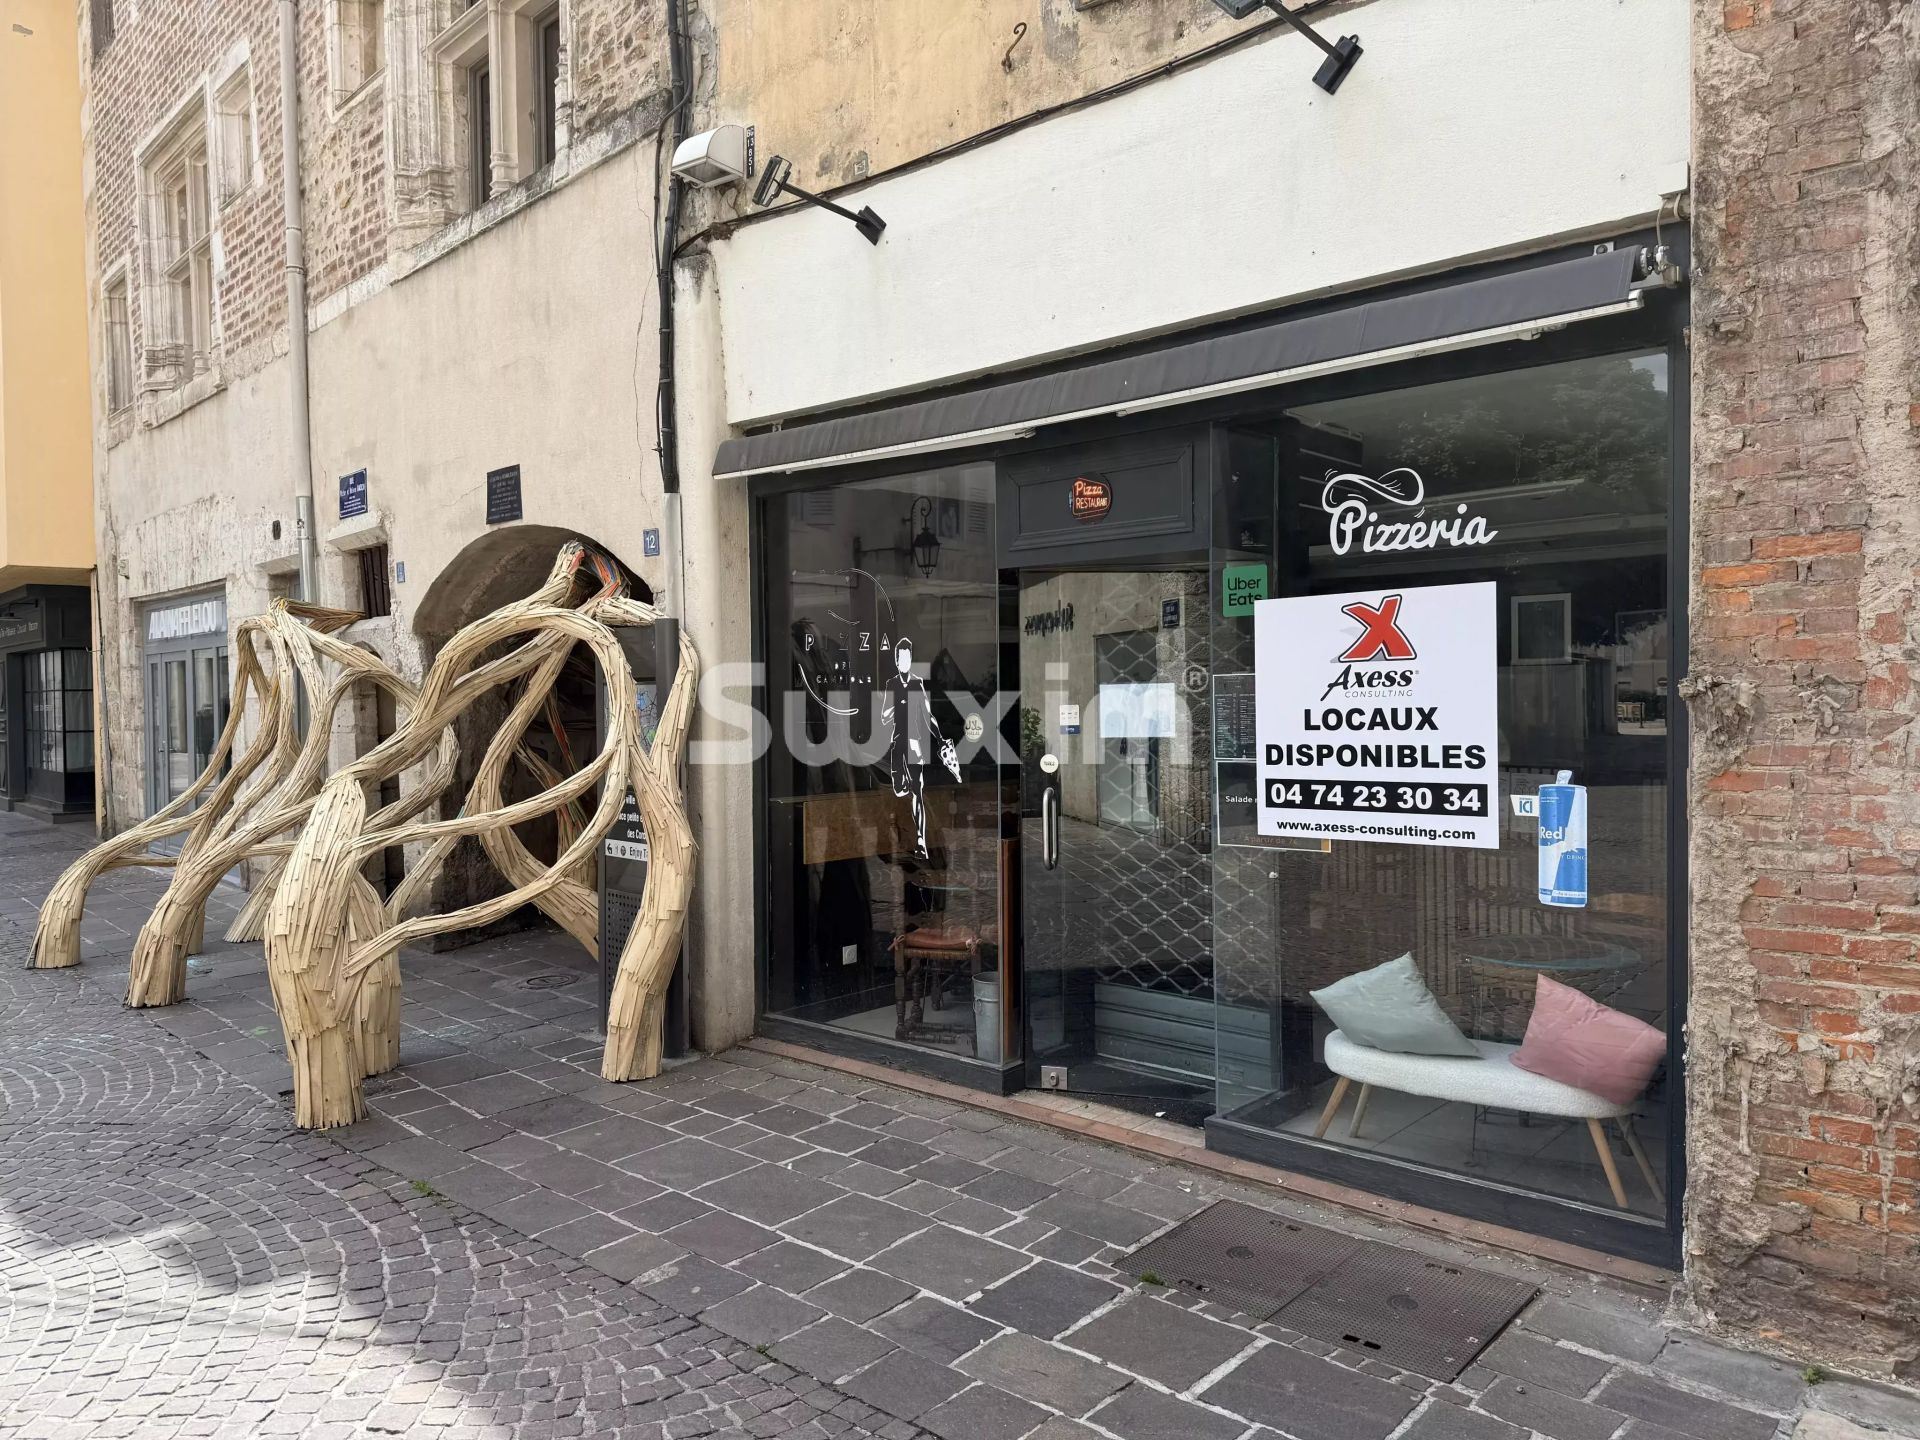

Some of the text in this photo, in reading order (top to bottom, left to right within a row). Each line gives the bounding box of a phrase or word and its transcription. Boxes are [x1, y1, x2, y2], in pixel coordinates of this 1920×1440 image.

[1074, 481, 1104, 496] Pizza
[1075, 498, 1108, 509] RESTAURANT
[645, 534, 656, 549] 12
[1227, 577, 1262, 591] Uber
[1228, 593, 1263, 607] Eats
[1320, 664, 1414, 701] Axess
[1344, 689, 1413, 699] CONSULTING
[1303, 706, 1439, 731] LOCAUX
[1265, 743, 1487, 770] DISPONIBLES
[1225, 795, 1253, 804] Salade
[1270, 783, 1481, 811] 04 74 23 30 34
[1519, 800, 1533, 813] ICI
[1276, 819, 1476, 840] www.axess-consulting.com
[1540, 826, 1563, 840] Red
